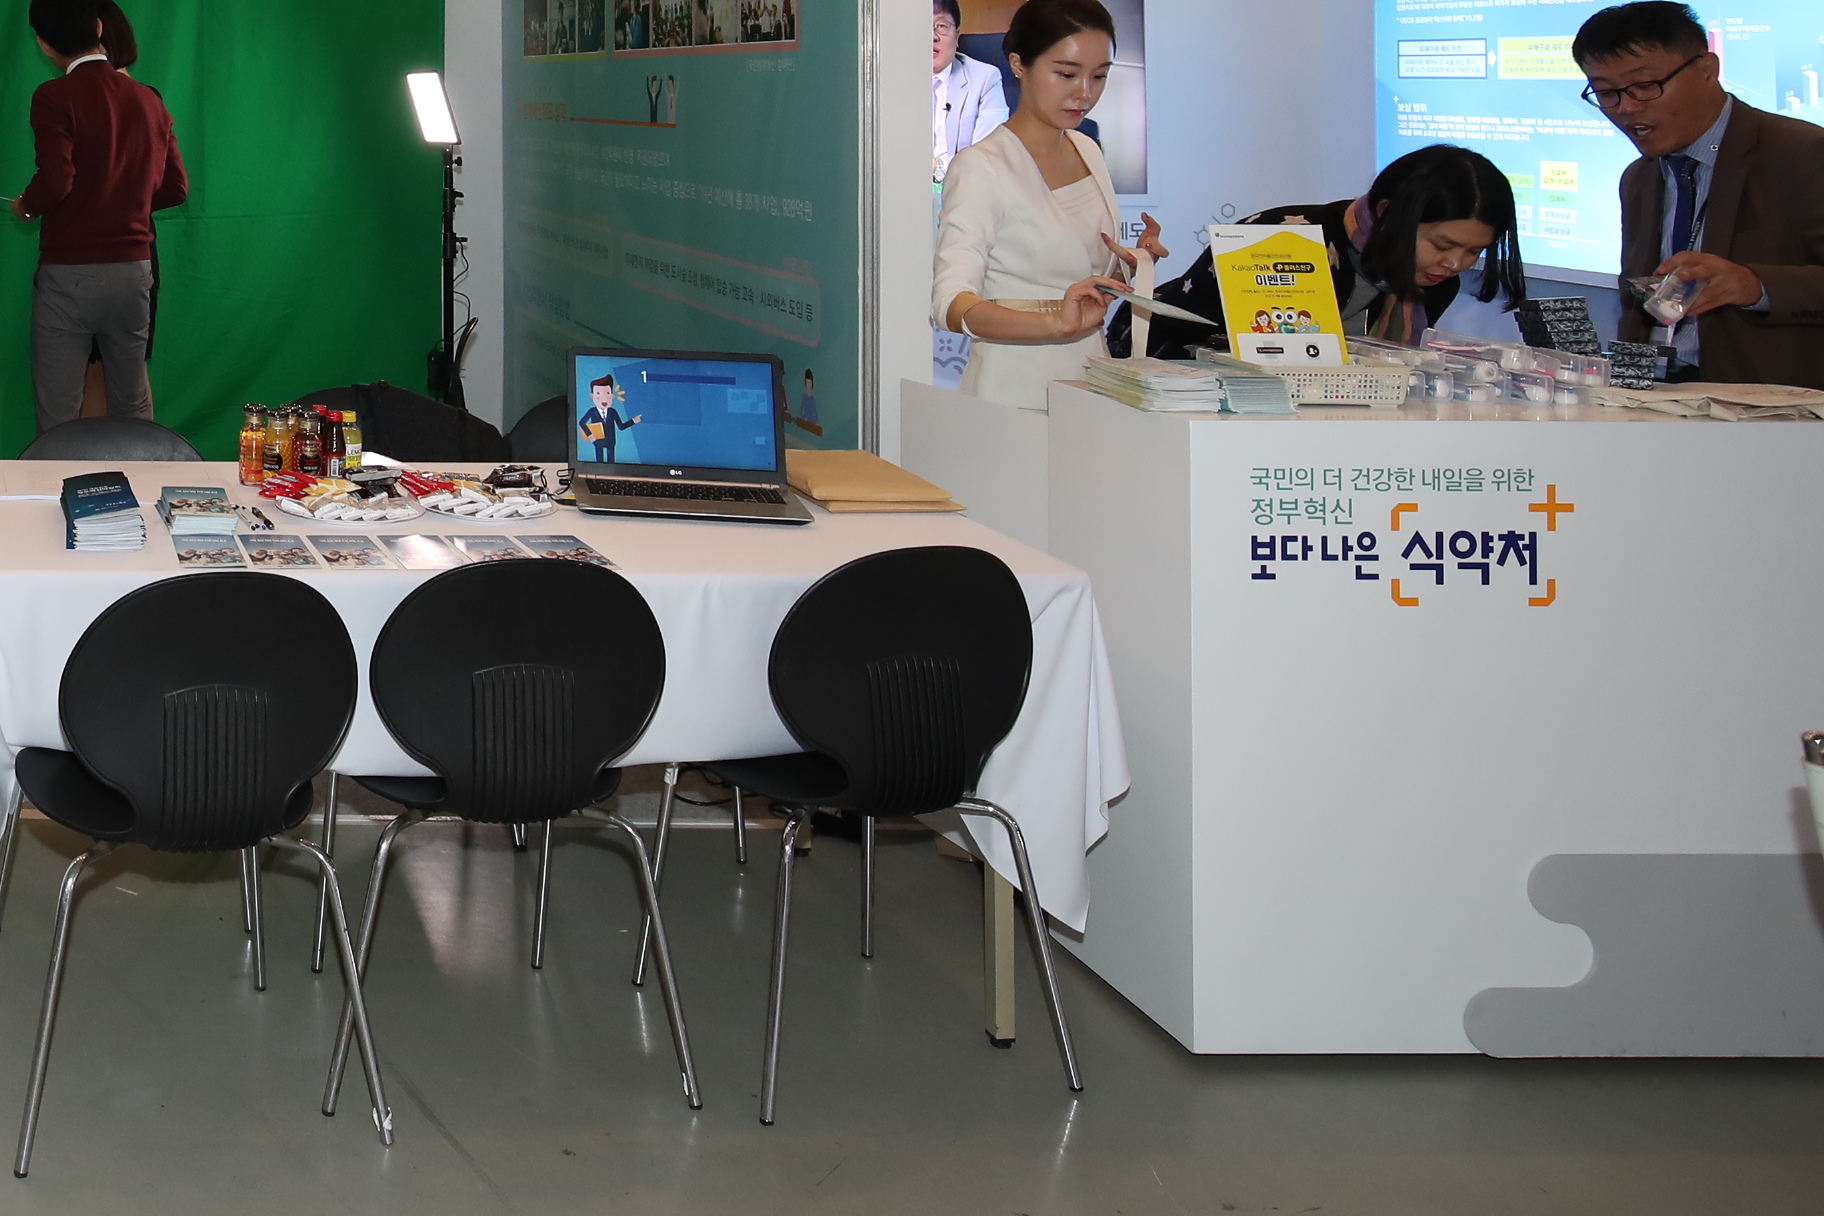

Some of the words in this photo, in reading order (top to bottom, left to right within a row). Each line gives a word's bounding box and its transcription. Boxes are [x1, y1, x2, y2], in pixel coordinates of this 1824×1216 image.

[1249, 466, 1314, 492] 국민의
[1322, 467, 1342, 491] 더
[1350, 467, 1416, 492] 건강한
[1421, 467, 1486, 492] 내일을
[1490, 468, 1535, 493] 위한
[1250, 496, 1354, 526] 정부혁신
[1400, 529, 1538, 587] 식약처
